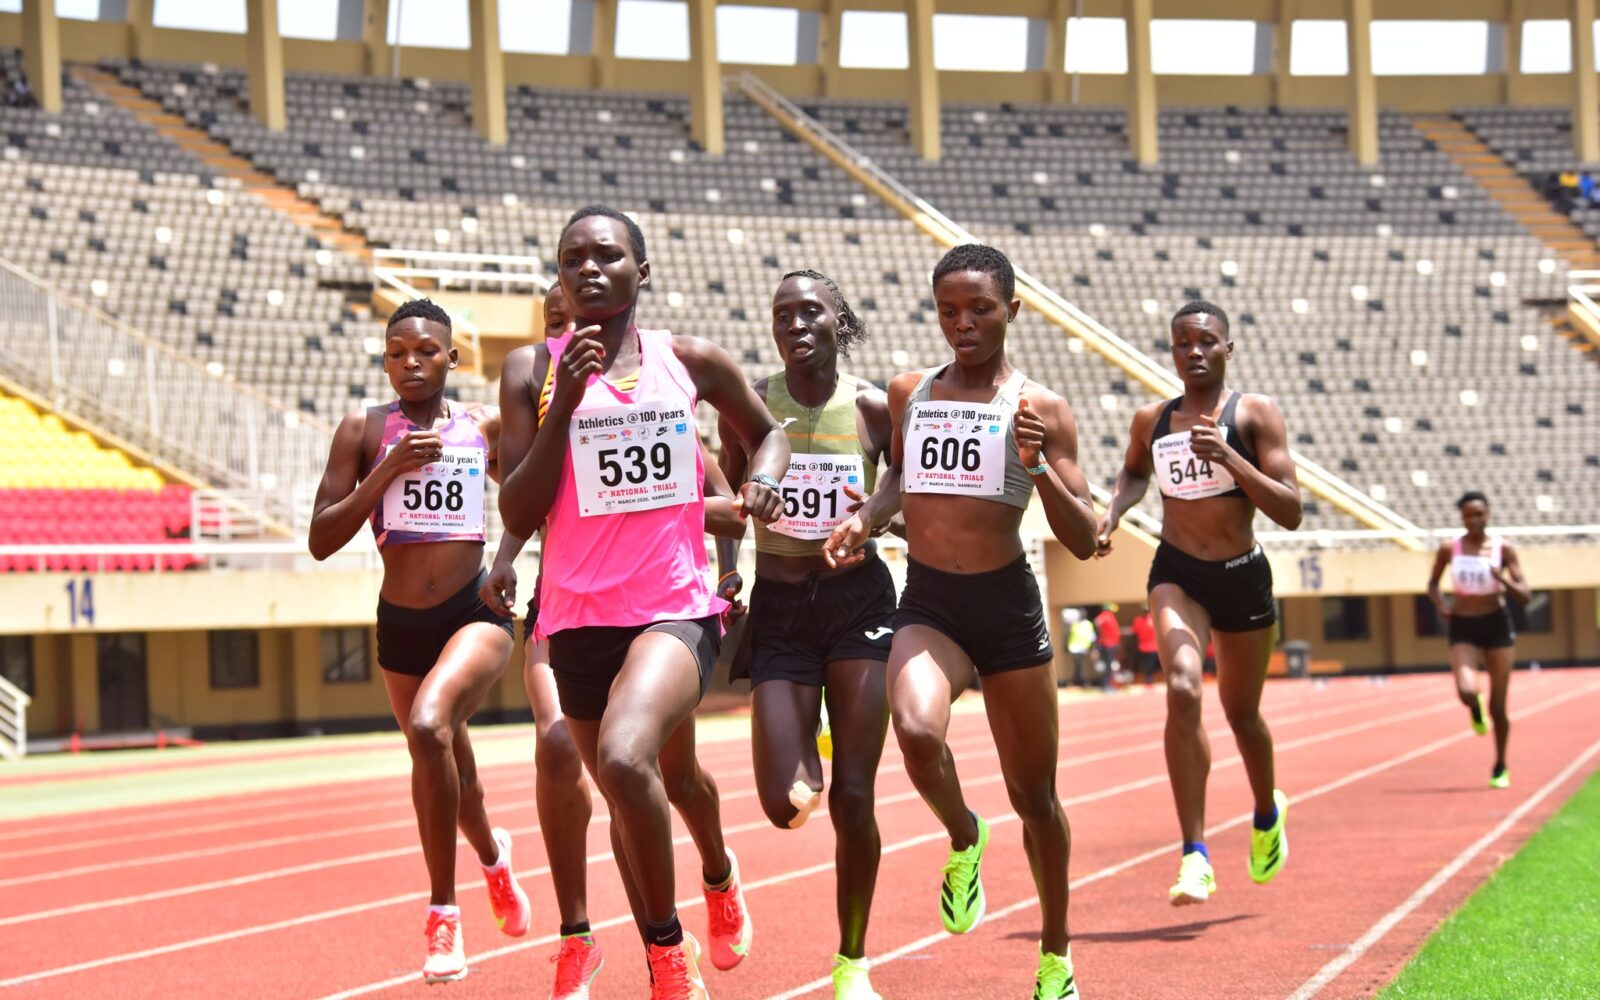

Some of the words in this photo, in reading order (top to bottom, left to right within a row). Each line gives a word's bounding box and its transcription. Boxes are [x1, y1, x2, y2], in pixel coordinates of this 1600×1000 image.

[578, 414, 625, 430] Athletics
[659, 409, 685, 423] years
[917, 409, 948, 419] Athletics
[977, 413, 1001, 421] years
[457, 456, 478, 465] years
[598, 442, 672, 487] 539
[920, 436, 981, 472] 606
[787, 461, 807, 471] etics
[835, 463, 857, 473] years
[925, 472, 956, 480] NATIONAL
[960, 474, 985, 482] TRIALS
[1169, 458, 1214, 485] 544
[403, 479, 464, 512] 568
[610, 486, 649, 498] NATIONAL
[652, 482, 678, 493] TRIALS
[782, 487, 838, 519] 591
[788, 520, 818, 528] NATIONAL
[1225, 555, 1249, 570] NIKE
[1298, 556, 1323, 589] 15
[66, 578, 95, 625] 14
